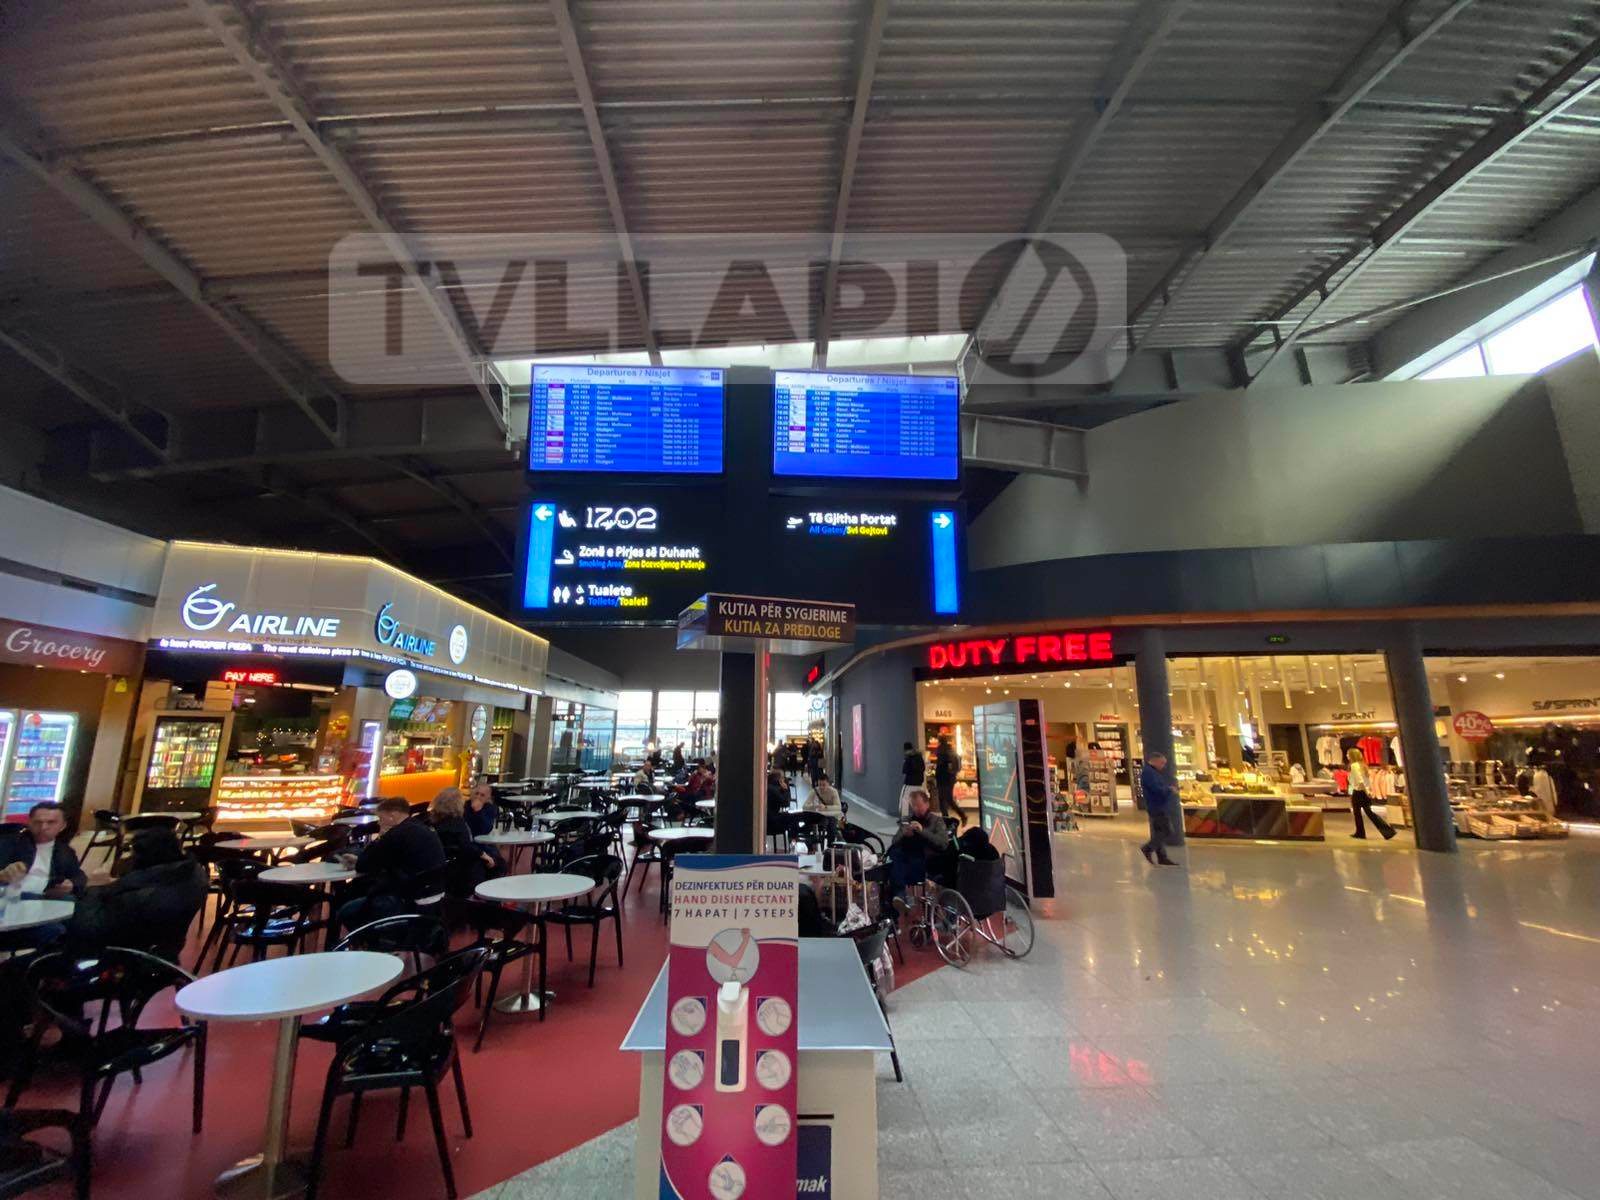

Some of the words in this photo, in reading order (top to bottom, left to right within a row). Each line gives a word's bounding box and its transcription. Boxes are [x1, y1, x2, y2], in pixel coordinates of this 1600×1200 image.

[587, 368, 636, 377] Departures
[827, 375, 874, 384] Departures
[860, 513, 896, 525] Portat
[607, 549, 613, 557] e
[659, 546, 700, 558] Duhanit
[719, 602, 757, 616] KUTIA
[761, 602, 782, 618] PËR
[785, 606, 847, 624] SYGJERIME
[228, 614, 340, 638] AIRLINE
[725, 619, 761, 633] KUTIA
[765, 622, 780, 635] ZA
[784, 623, 841, 639] PREDLOGE
[6, 628, 107, 667] Grocery
[393, 632, 436, 657] AIRLINE
[929, 638, 1005, 669] DUTY
[1015, 632, 1113, 663] FREE
[225, 671, 246, 682] PAY
[1455, 716, 1492, 730] 40%
[746, 879, 764, 890] PËR
[767, 881, 795, 890] DUAR
[674, 895, 708, 904] HAND
[711, 895, 794, 904] DISINFECTANT
[674, 909, 680, 917] 7
[685, 909, 728, 918] HAPAT
[743, 909, 750, 917] 7
[754, 909, 794, 918] STEPS
